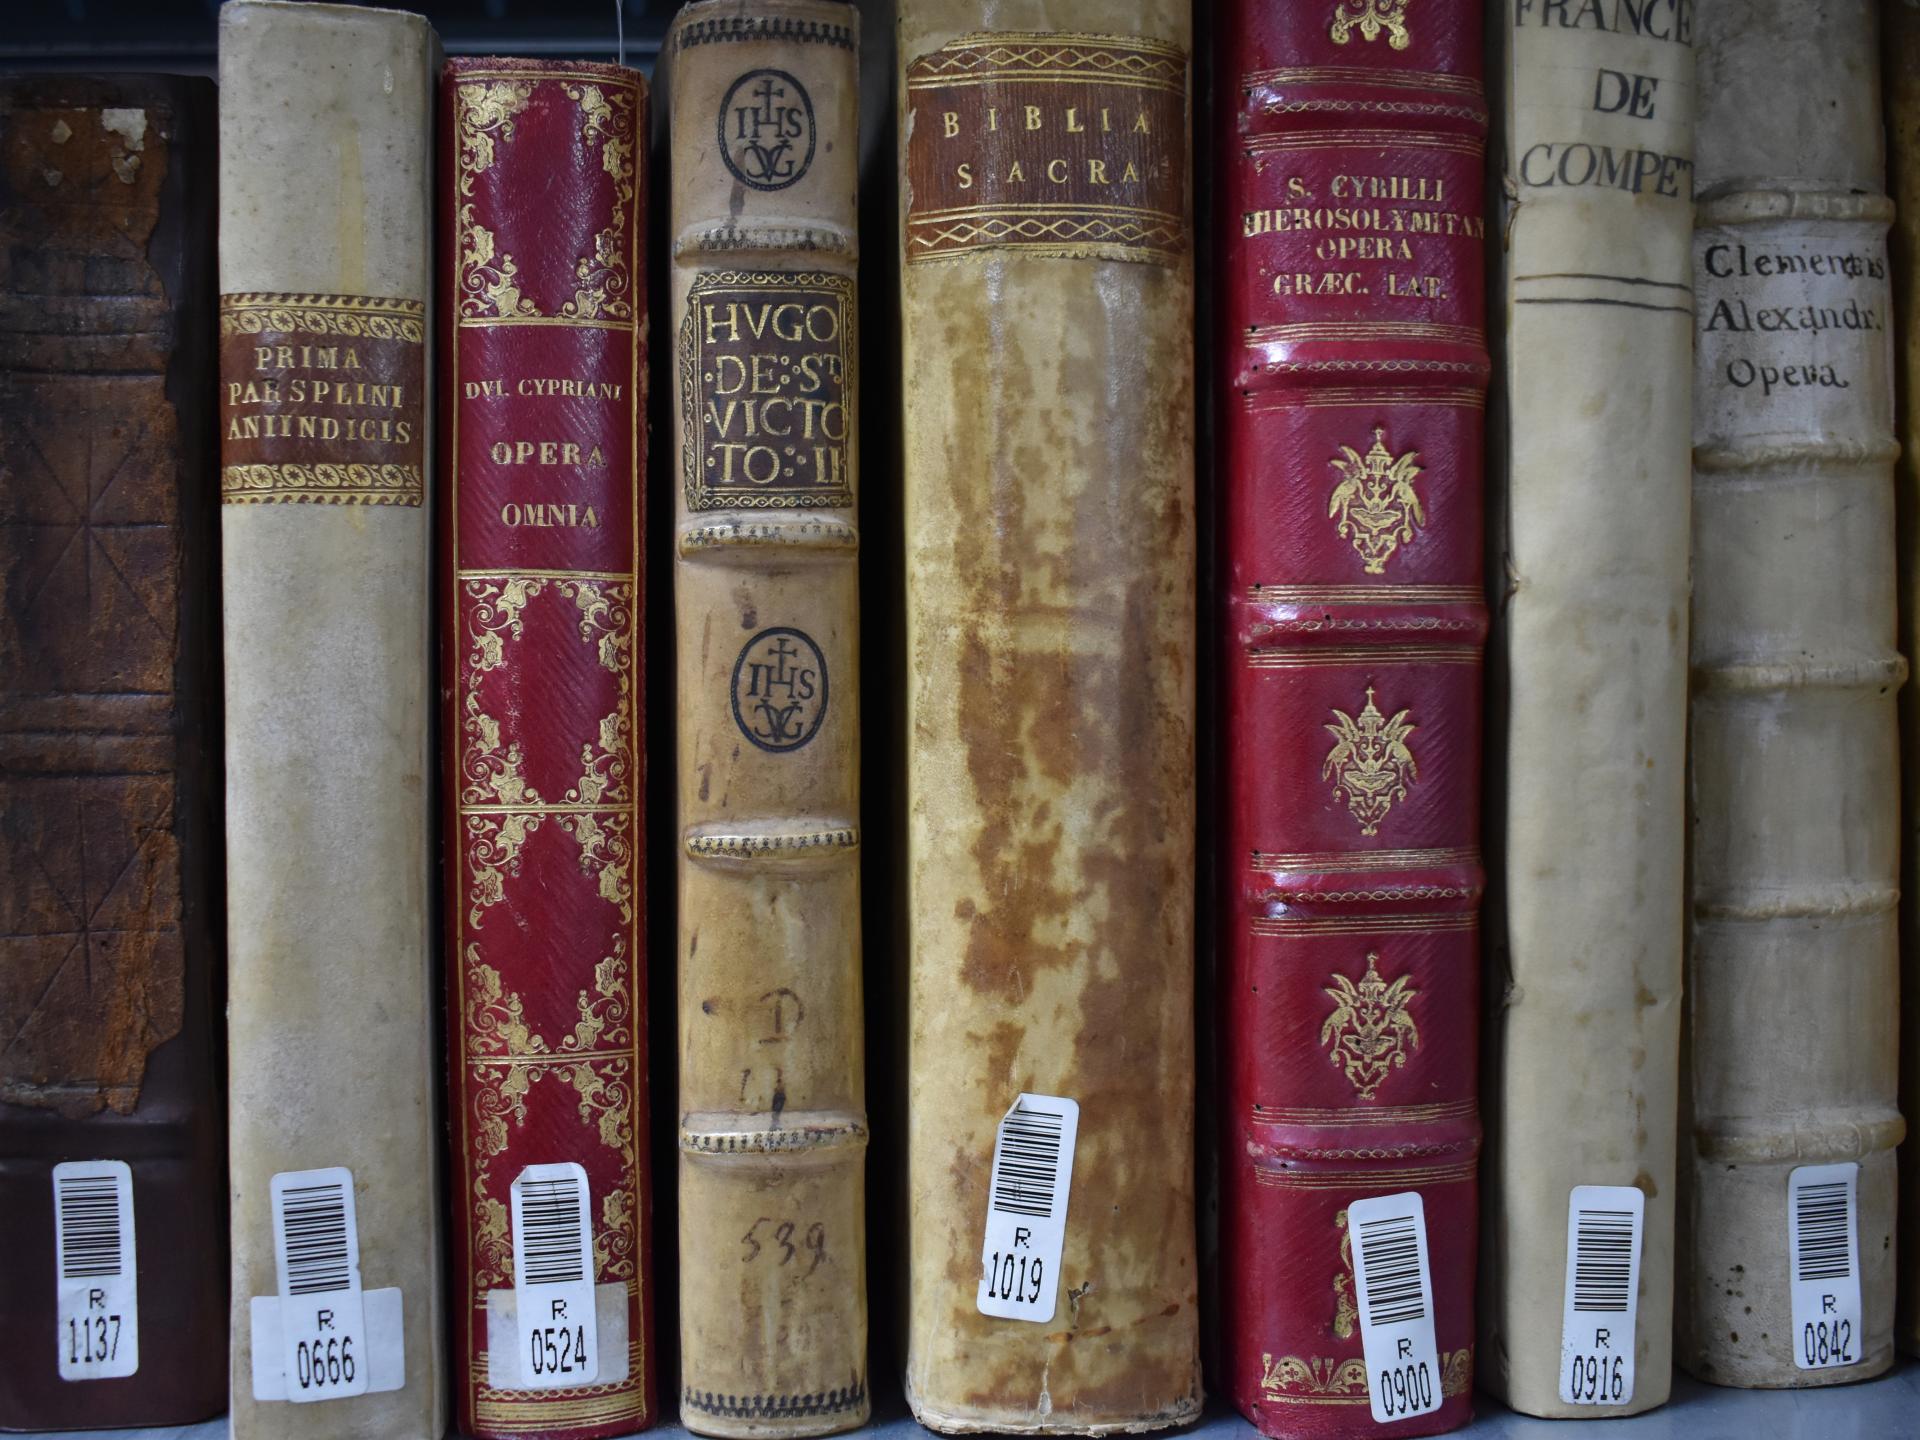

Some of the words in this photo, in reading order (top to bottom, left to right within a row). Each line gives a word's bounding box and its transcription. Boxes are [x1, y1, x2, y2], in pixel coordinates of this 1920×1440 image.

[1593, 68, 1659, 120] DE
[943, 105, 1151, 138] BIBLIA
[957, 159, 1140, 189] SACRA
[1288, 177, 1312, 199] S.
[1316, 237, 1414, 260] OPERA
[703, 303, 839, 344] HVGO
[255, 346, 361, 370] PRIMA
[518, 378, 622, 400] CYPRIANI
[491, 441, 607, 467] OPERA
[501, 503, 602, 527] OMNIA
[1015, 1227, 1031, 1248] R
[988, 1252, 1043, 1304] 1019
[89, 1288, 105, 1309] R
[551, 1299, 568, 1320] R
[1822, 1294, 1837, 1314] R
[318, 1309, 335, 1332] R
[70, 1315, 121, 1364] 1137
[531, 1325, 587, 1375] 0524
[1397, 1337, 1413, 1359] R
[1595, 1328, 1610, 1348] R
[1804, 1318, 1852, 1366] 0842
[297, 1336, 355, 1389] 0666
[1381, 1361, 1432, 1417] 0900
[1571, 1355, 1623, 1401] 0916
